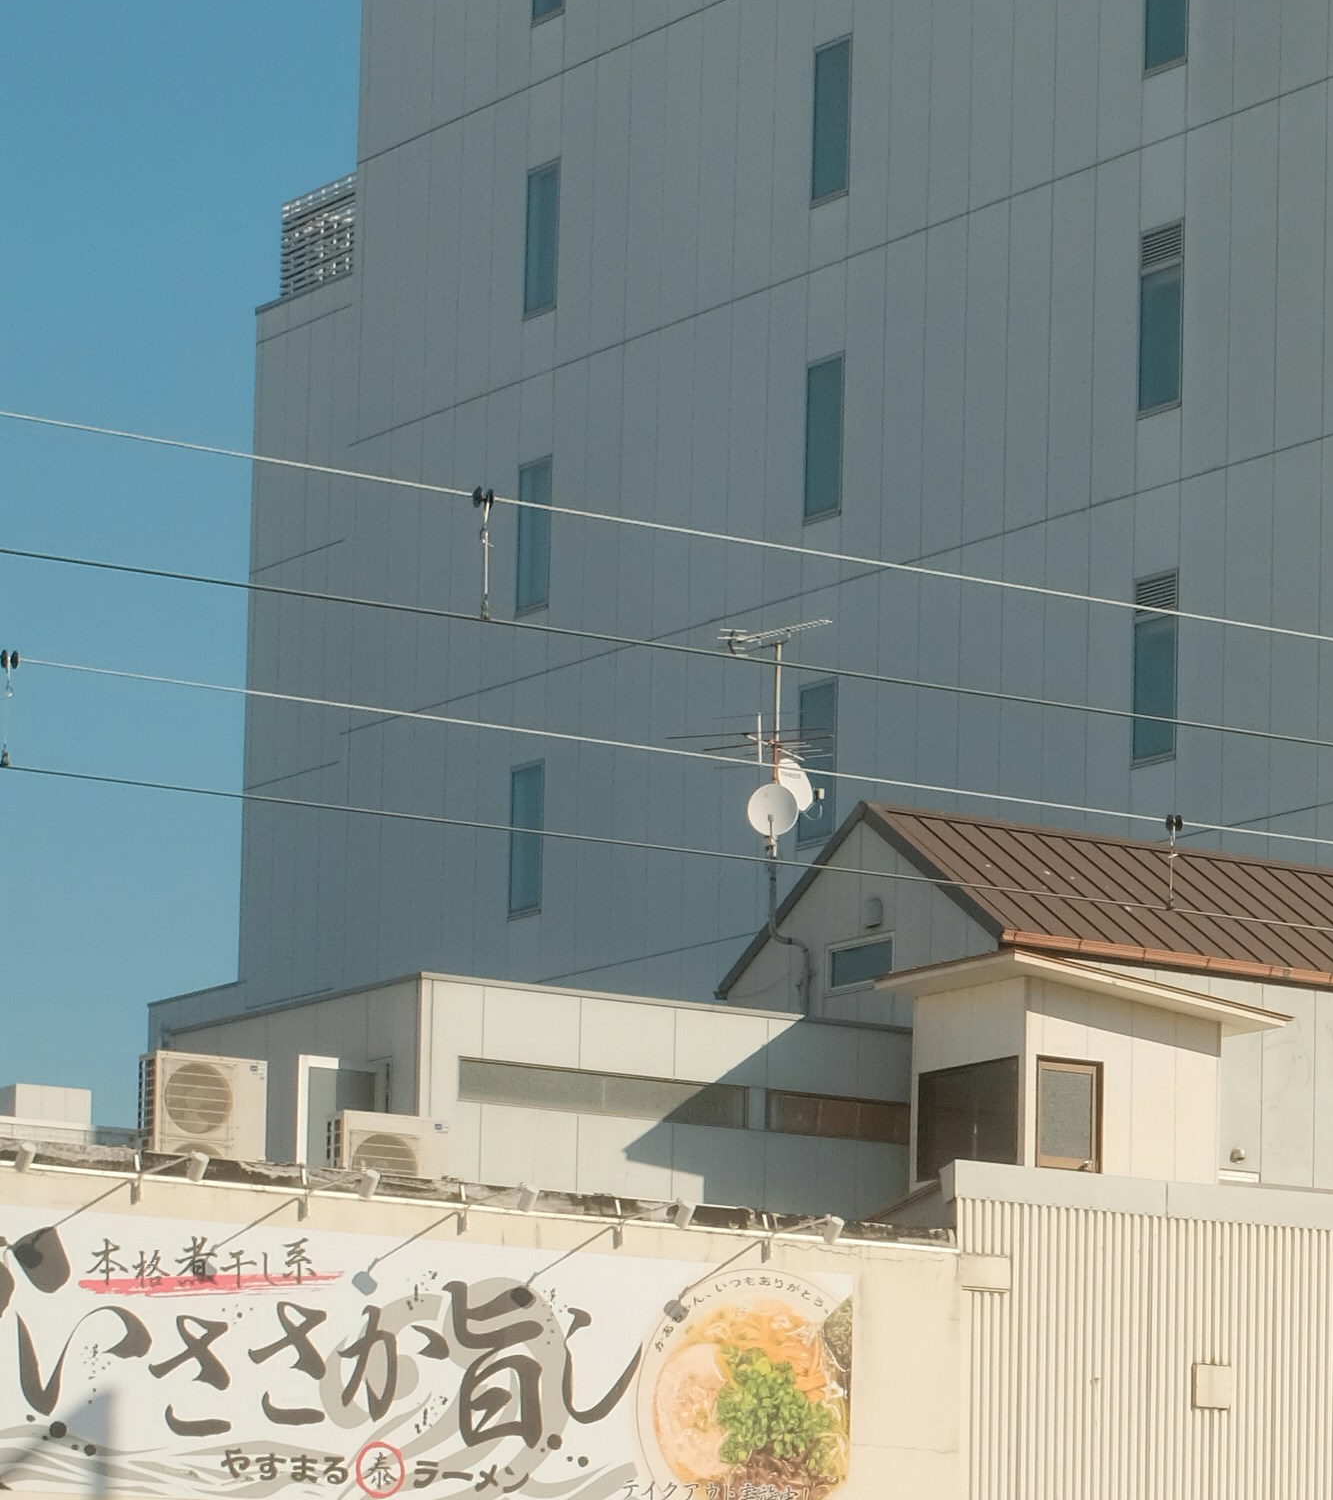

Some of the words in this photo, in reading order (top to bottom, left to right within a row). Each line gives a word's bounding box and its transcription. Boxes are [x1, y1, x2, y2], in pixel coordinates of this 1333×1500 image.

[86, 1236, 318, 1288] 本格煮干し系
[0, 1227, 642, 1450] いささか旨し
[221, 1448, 349, 1485] やすまる
[413, 1460, 529, 1493] ラーメン
